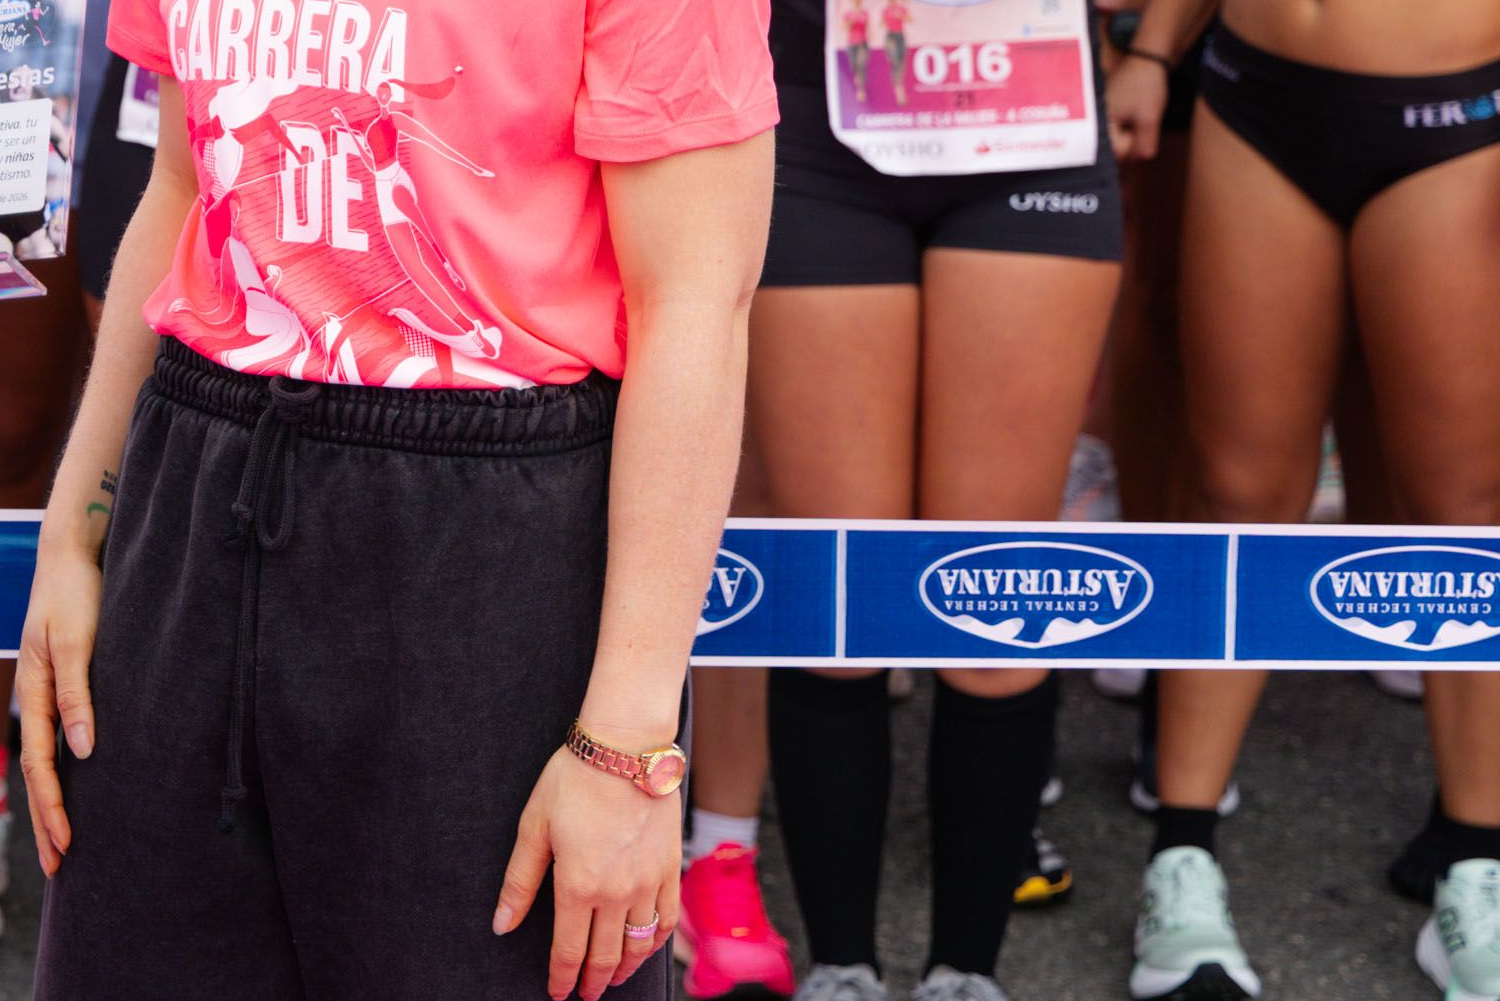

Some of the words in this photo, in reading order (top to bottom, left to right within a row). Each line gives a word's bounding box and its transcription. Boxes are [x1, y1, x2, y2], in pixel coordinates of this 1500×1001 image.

[913, 42, 1012, 86] 016
[26, 117, 38, 128] tu
[4, 137, 21, 148] ser
[22, 135, 36, 146] un
[5, 150, 35, 164] niñas
[276, 120, 369, 252] DE
[1009, 191, 1100, 215] OYSHO
[936, 568, 1137, 610] ASTURIANA
[1328, 571, 1500, 600] STURIANA
[944, 600, 1018, 611] LECHERA
[1026, 600, 1100, 612] CENTRAL
[1335, 602, 1411, 614] LECHERA
[1416, 603, 1492, 615] CENTRAL
